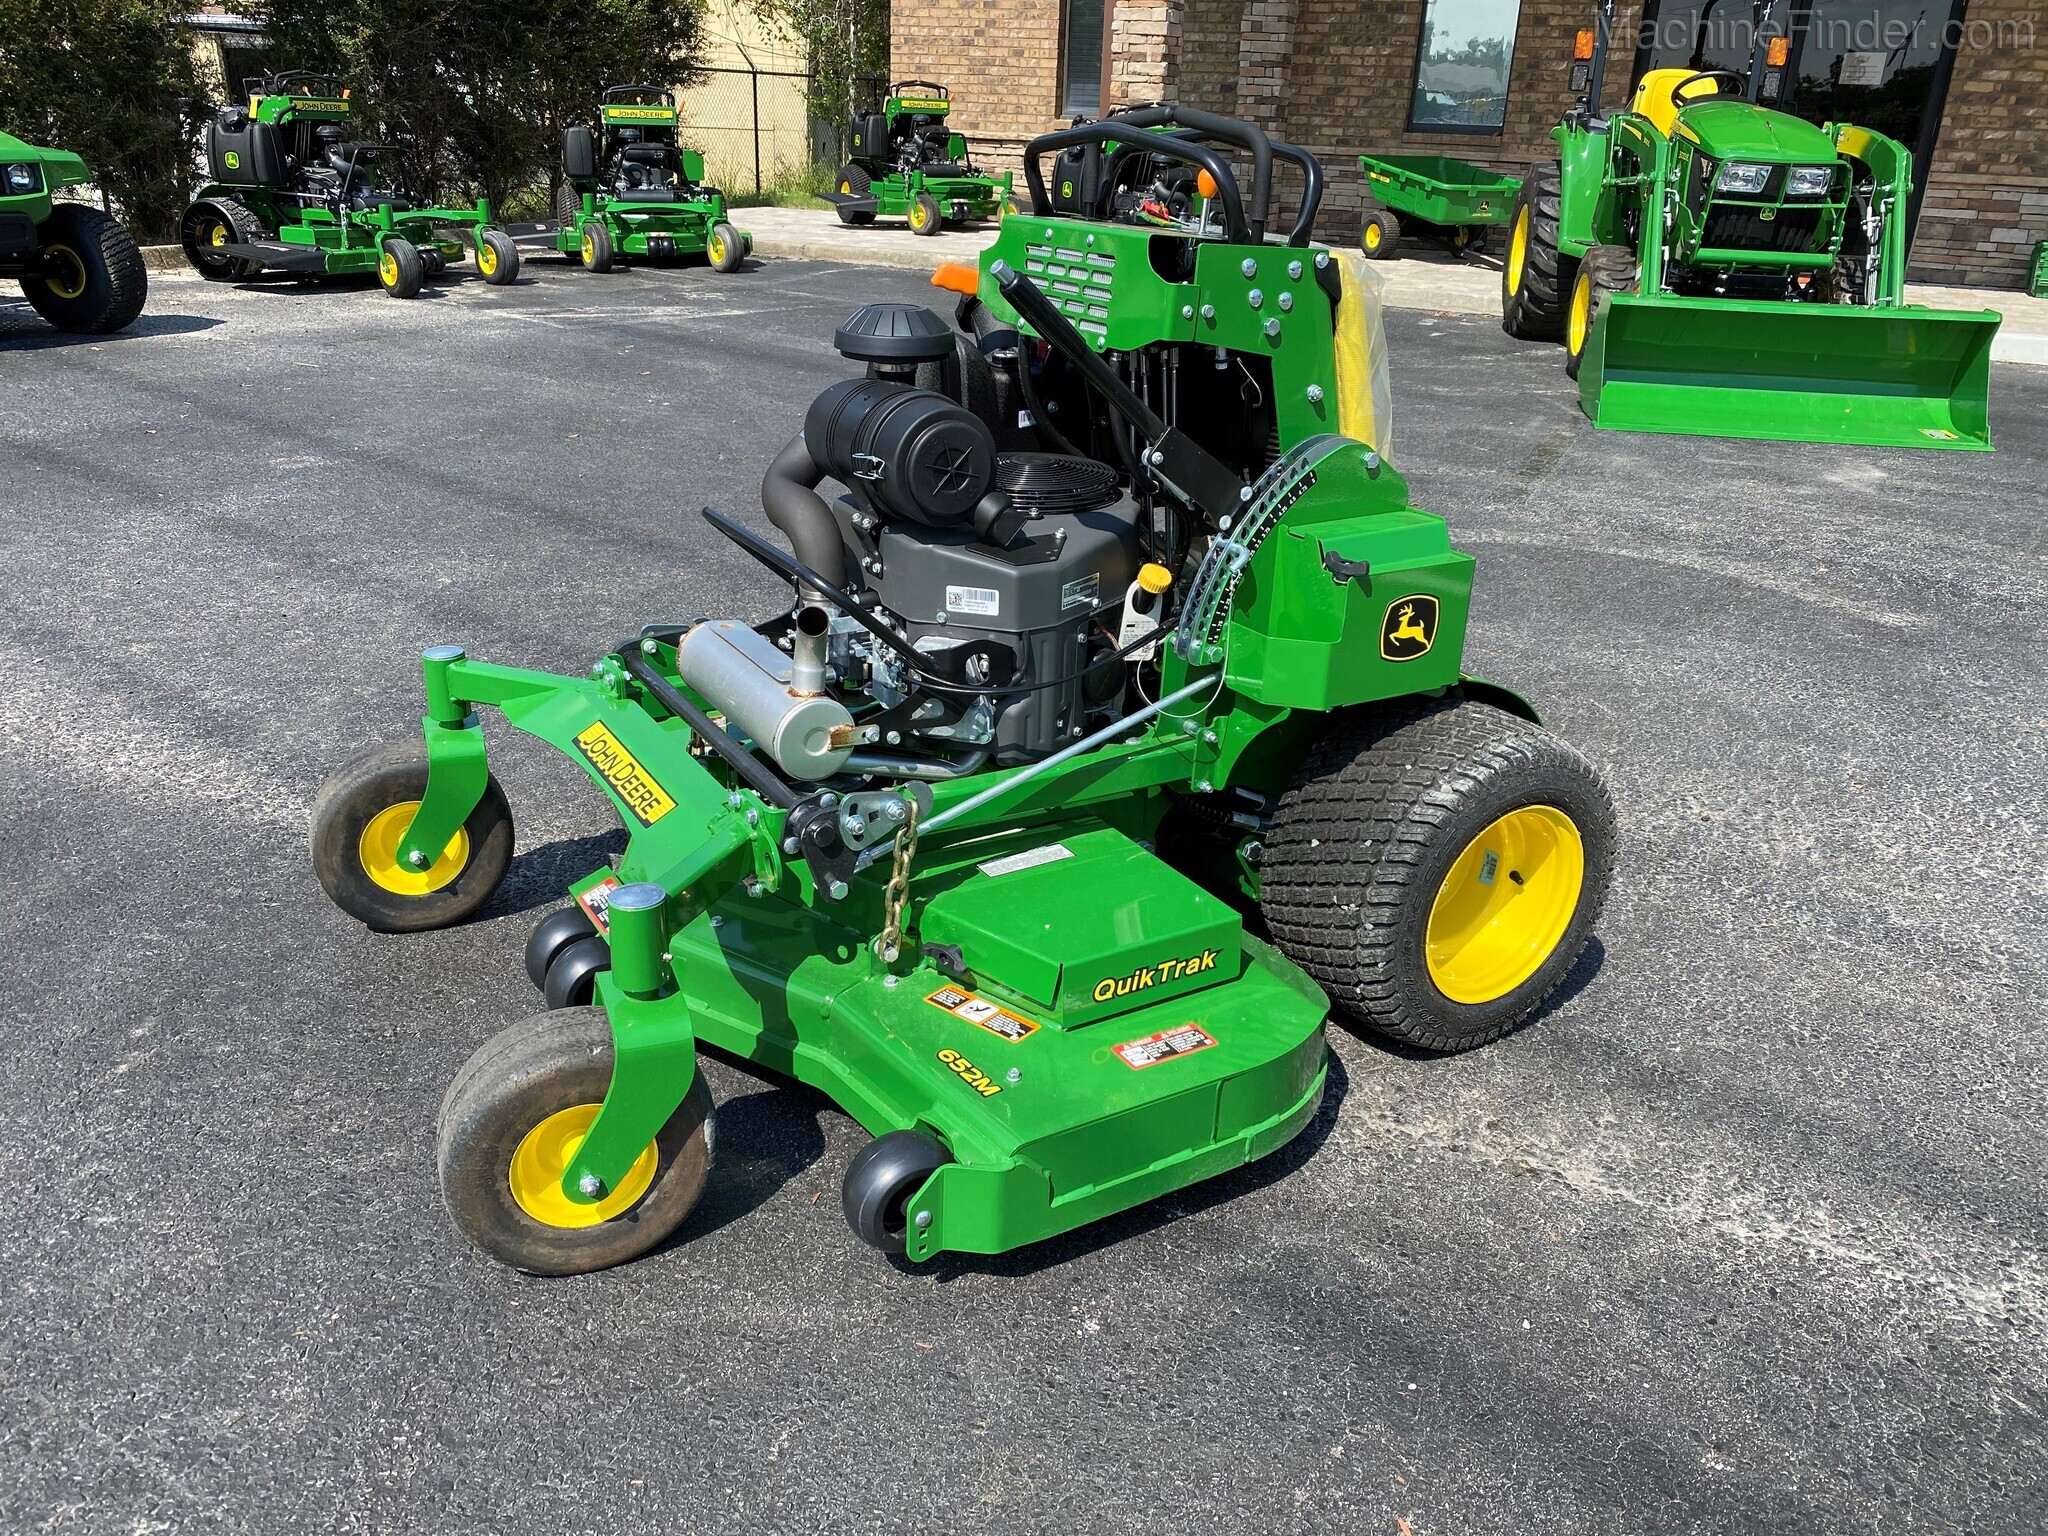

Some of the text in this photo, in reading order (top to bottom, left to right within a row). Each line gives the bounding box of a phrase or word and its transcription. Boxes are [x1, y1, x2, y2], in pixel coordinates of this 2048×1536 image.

[301, 102, 342, 110] JOHN DEERE
[640, 110, 665, 118] DEERE
[582, 732, 662, 816] JOHN DEERE
[937, 1049, 1003, 1098] 652M
